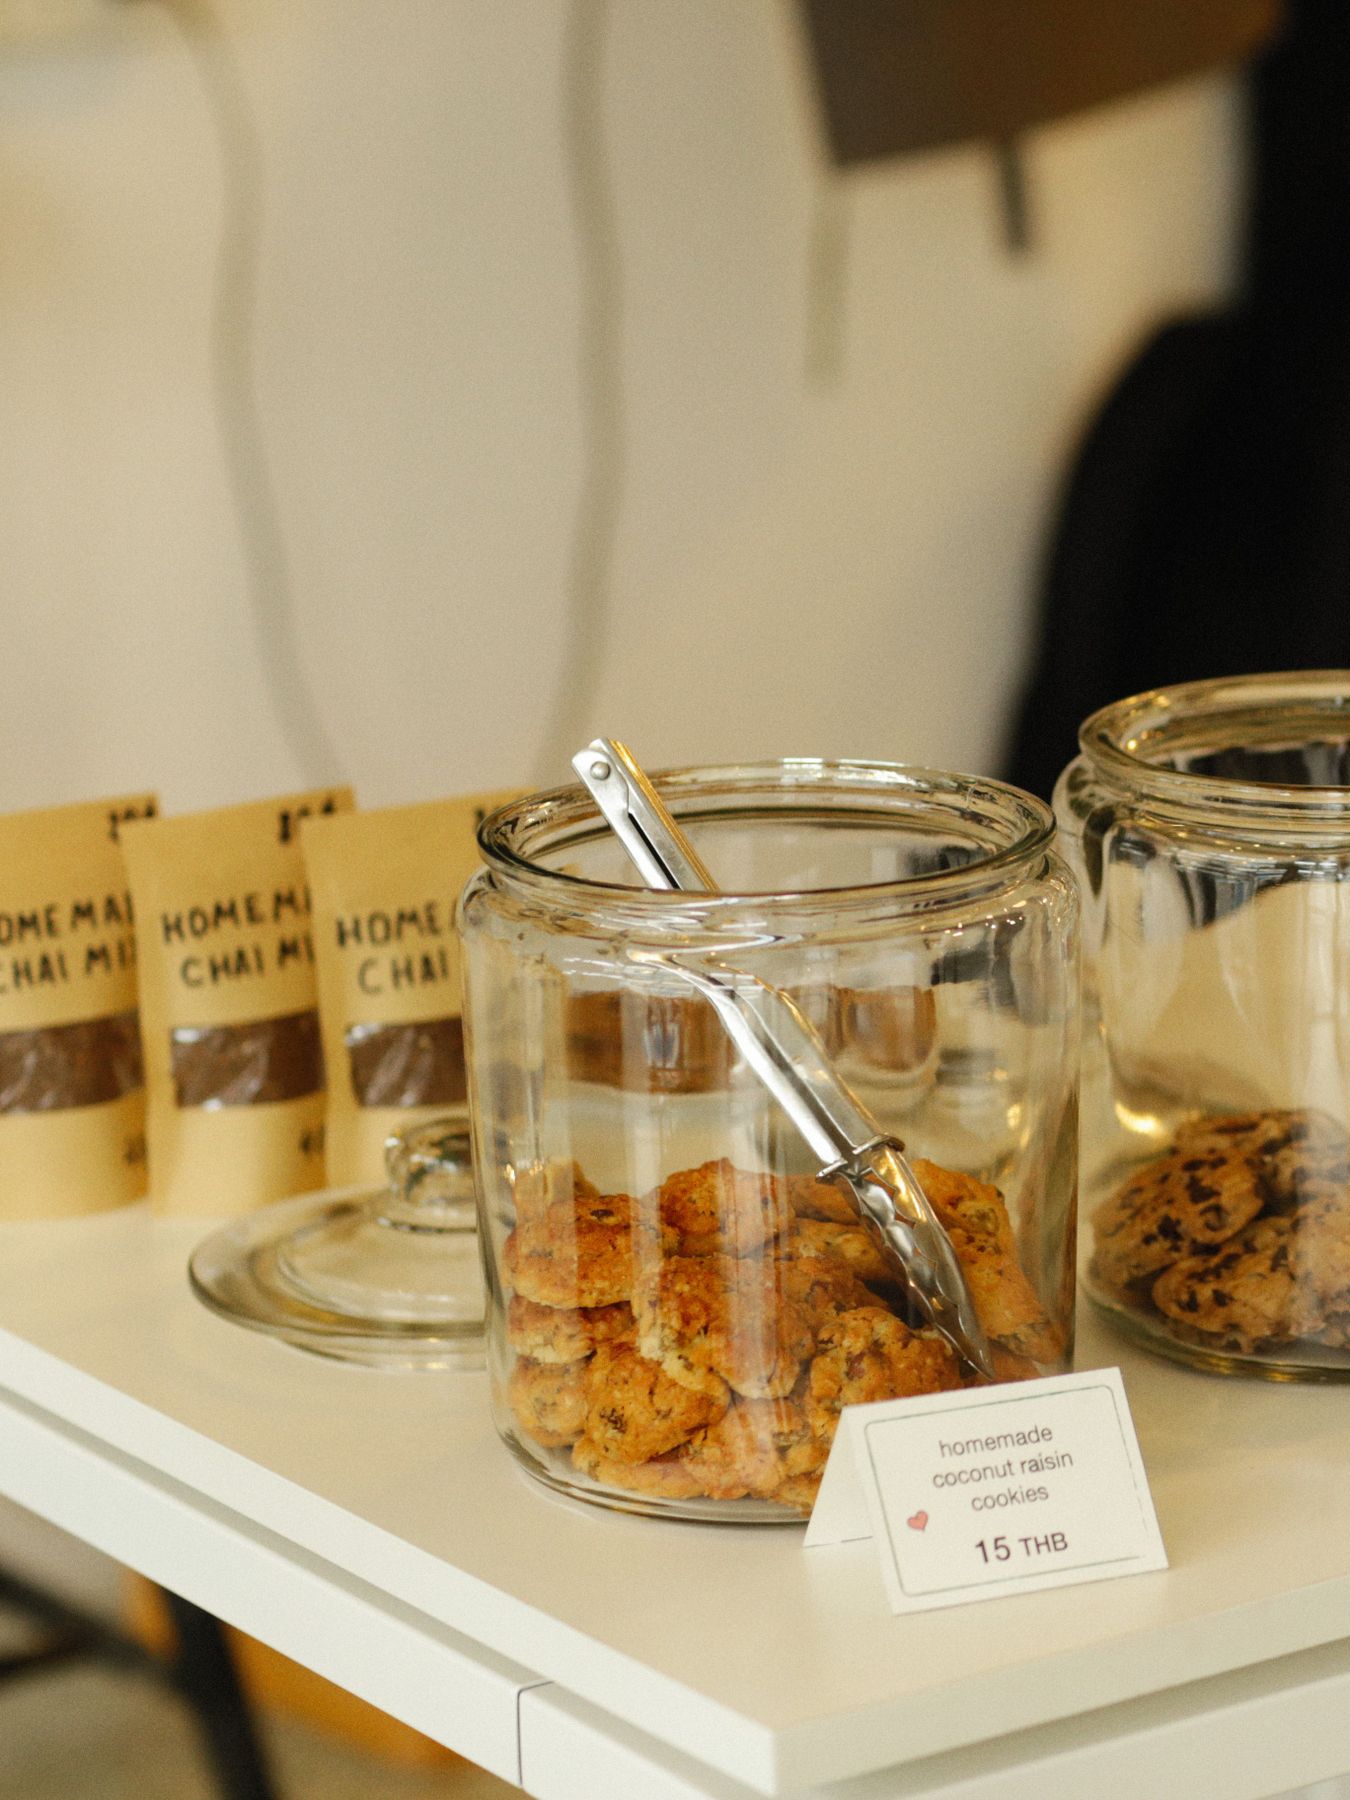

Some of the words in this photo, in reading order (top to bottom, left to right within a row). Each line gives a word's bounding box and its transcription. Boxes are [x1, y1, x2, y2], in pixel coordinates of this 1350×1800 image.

[0, 953, 68, 990] HAI
[180, 943, 264, 988] CHAI
[278, 932, 315, 969] MI
[357, 945, 449, 995] CHAI
[938, 1425, 1053, 1458] homemade
[932, 1460, 1016, 1489] coconut
[1020, 1450, 1074, 1474] raisin
[971, 1484, 1050, 1512] cookies
[975, 1536, 1012, 1564] 15
[1018, 1531, 1069, 1558] THB
